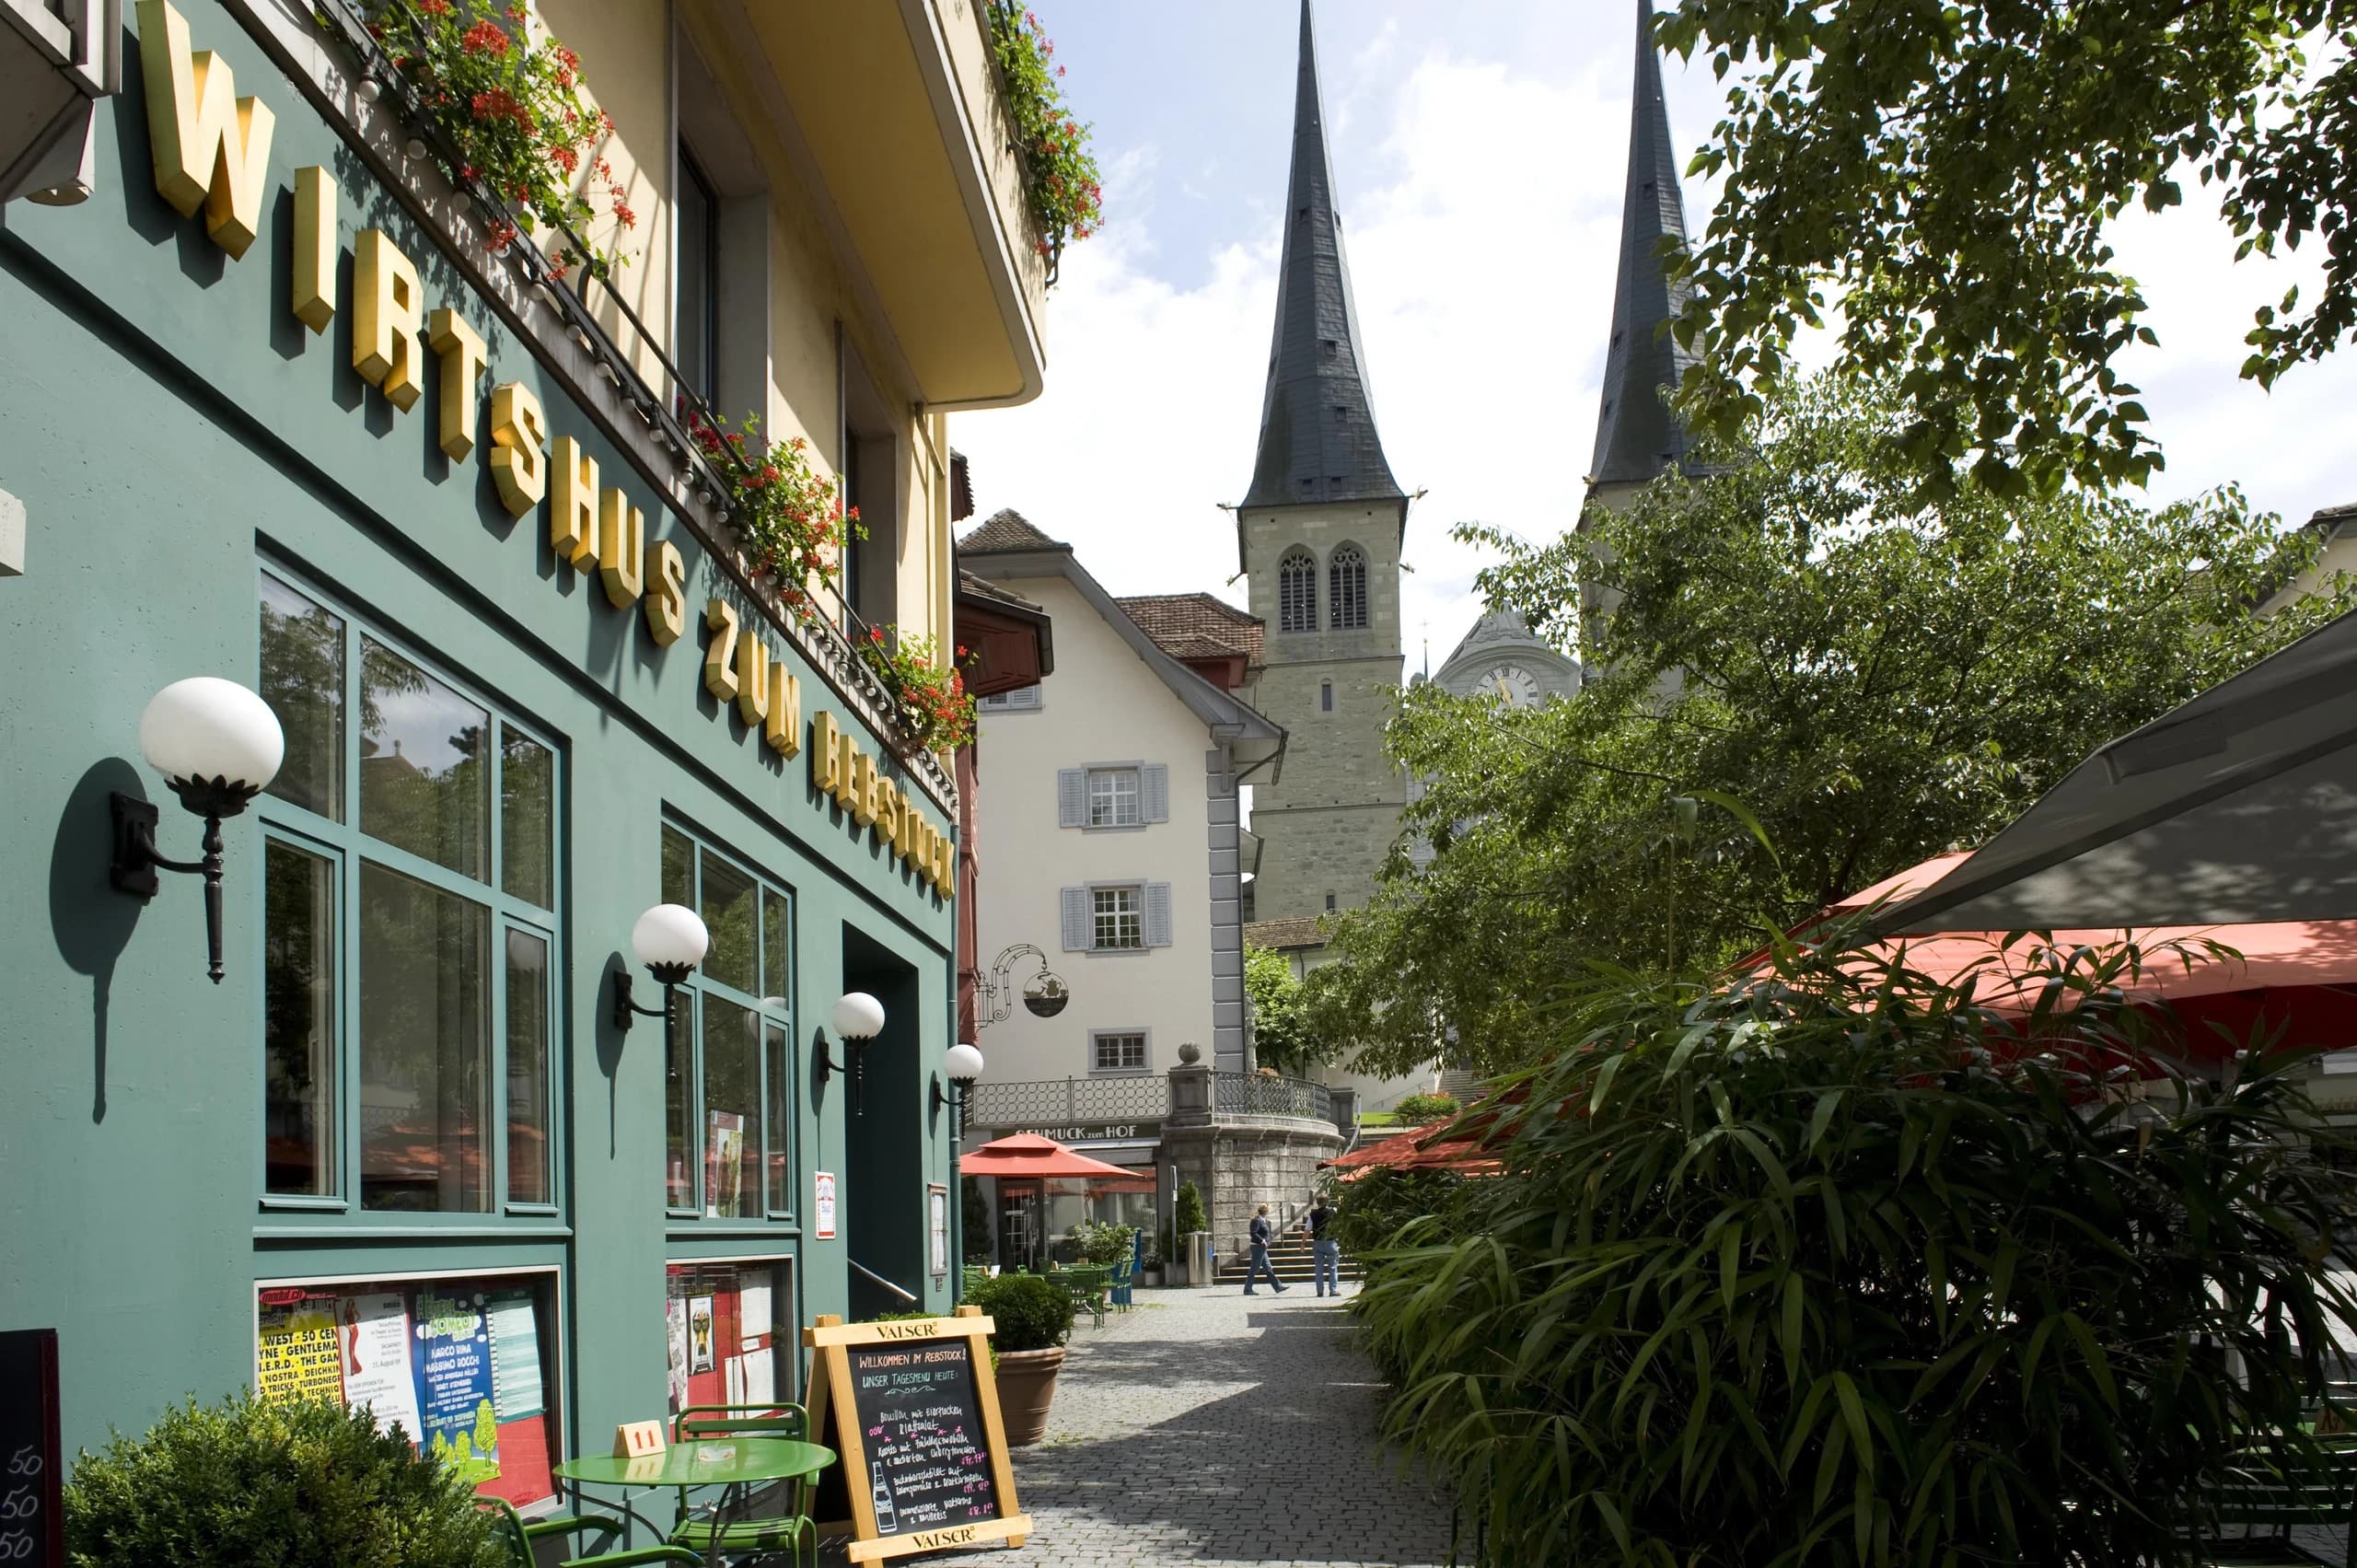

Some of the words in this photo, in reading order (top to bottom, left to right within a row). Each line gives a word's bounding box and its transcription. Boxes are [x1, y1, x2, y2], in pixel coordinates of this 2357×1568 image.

[136, 0, 685, 647] WIRTSHUS
[705, 598, 801, 762] ZUM
[814, 710, 956, 901] REBSTOCK
[1106, 1125, 1137, 1138] HOF
[264, 1332, 294, 1347] WEST
[302, 1330, 316, 1342] 50
[877, 1324, 935, 1340] VALSER
[286, 1341, 338, 1355] GENTLEMA
[259, 1359, 294, 1372] .E.R.D.
[300, 1355, 317, 1366] THE
[859, 1353, 910, 1369] WILLKOMMEN
[913, 1353, 921, 1365] IM
[924, 1347, 967, 1363] REBSTOCK!
[265, 1371, 298, 1383] NOSTRA
[862, 1376, 888, 1388] UNSER
[935, 1370, 958, 1381] HEUTE:
[268, 1382, 295, 1392] TRICKS
[911, 1409, 923, 1418] mit
[868, 1425, 885, 1436] oder
[634, 1430, 656, 1449] 11
[912, 1528, 973, 1549] VALSER
